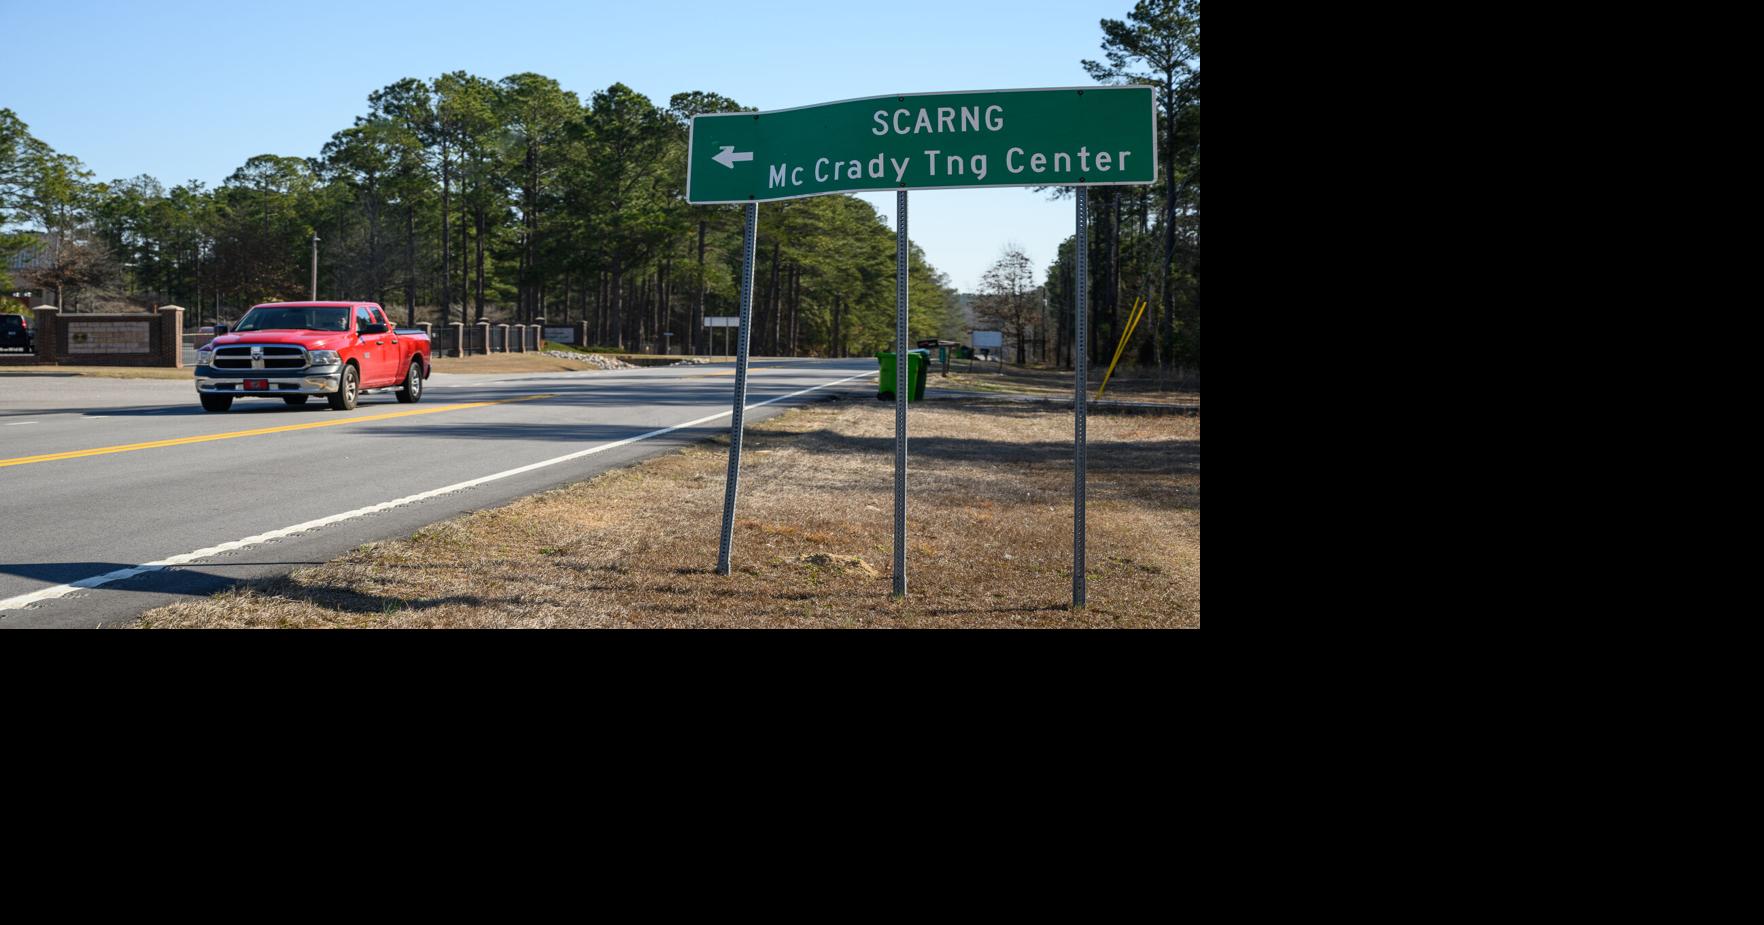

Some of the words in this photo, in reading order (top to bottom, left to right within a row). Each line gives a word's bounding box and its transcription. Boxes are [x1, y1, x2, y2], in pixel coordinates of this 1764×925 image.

[872, 105, 1004, 136] SCARNG
[769, 163, 803, 189] Mc
[815, 152, 910, 182] Crady
[924, 150, 988, 180] Tng
[1006, 146, 1131, 174] Center
